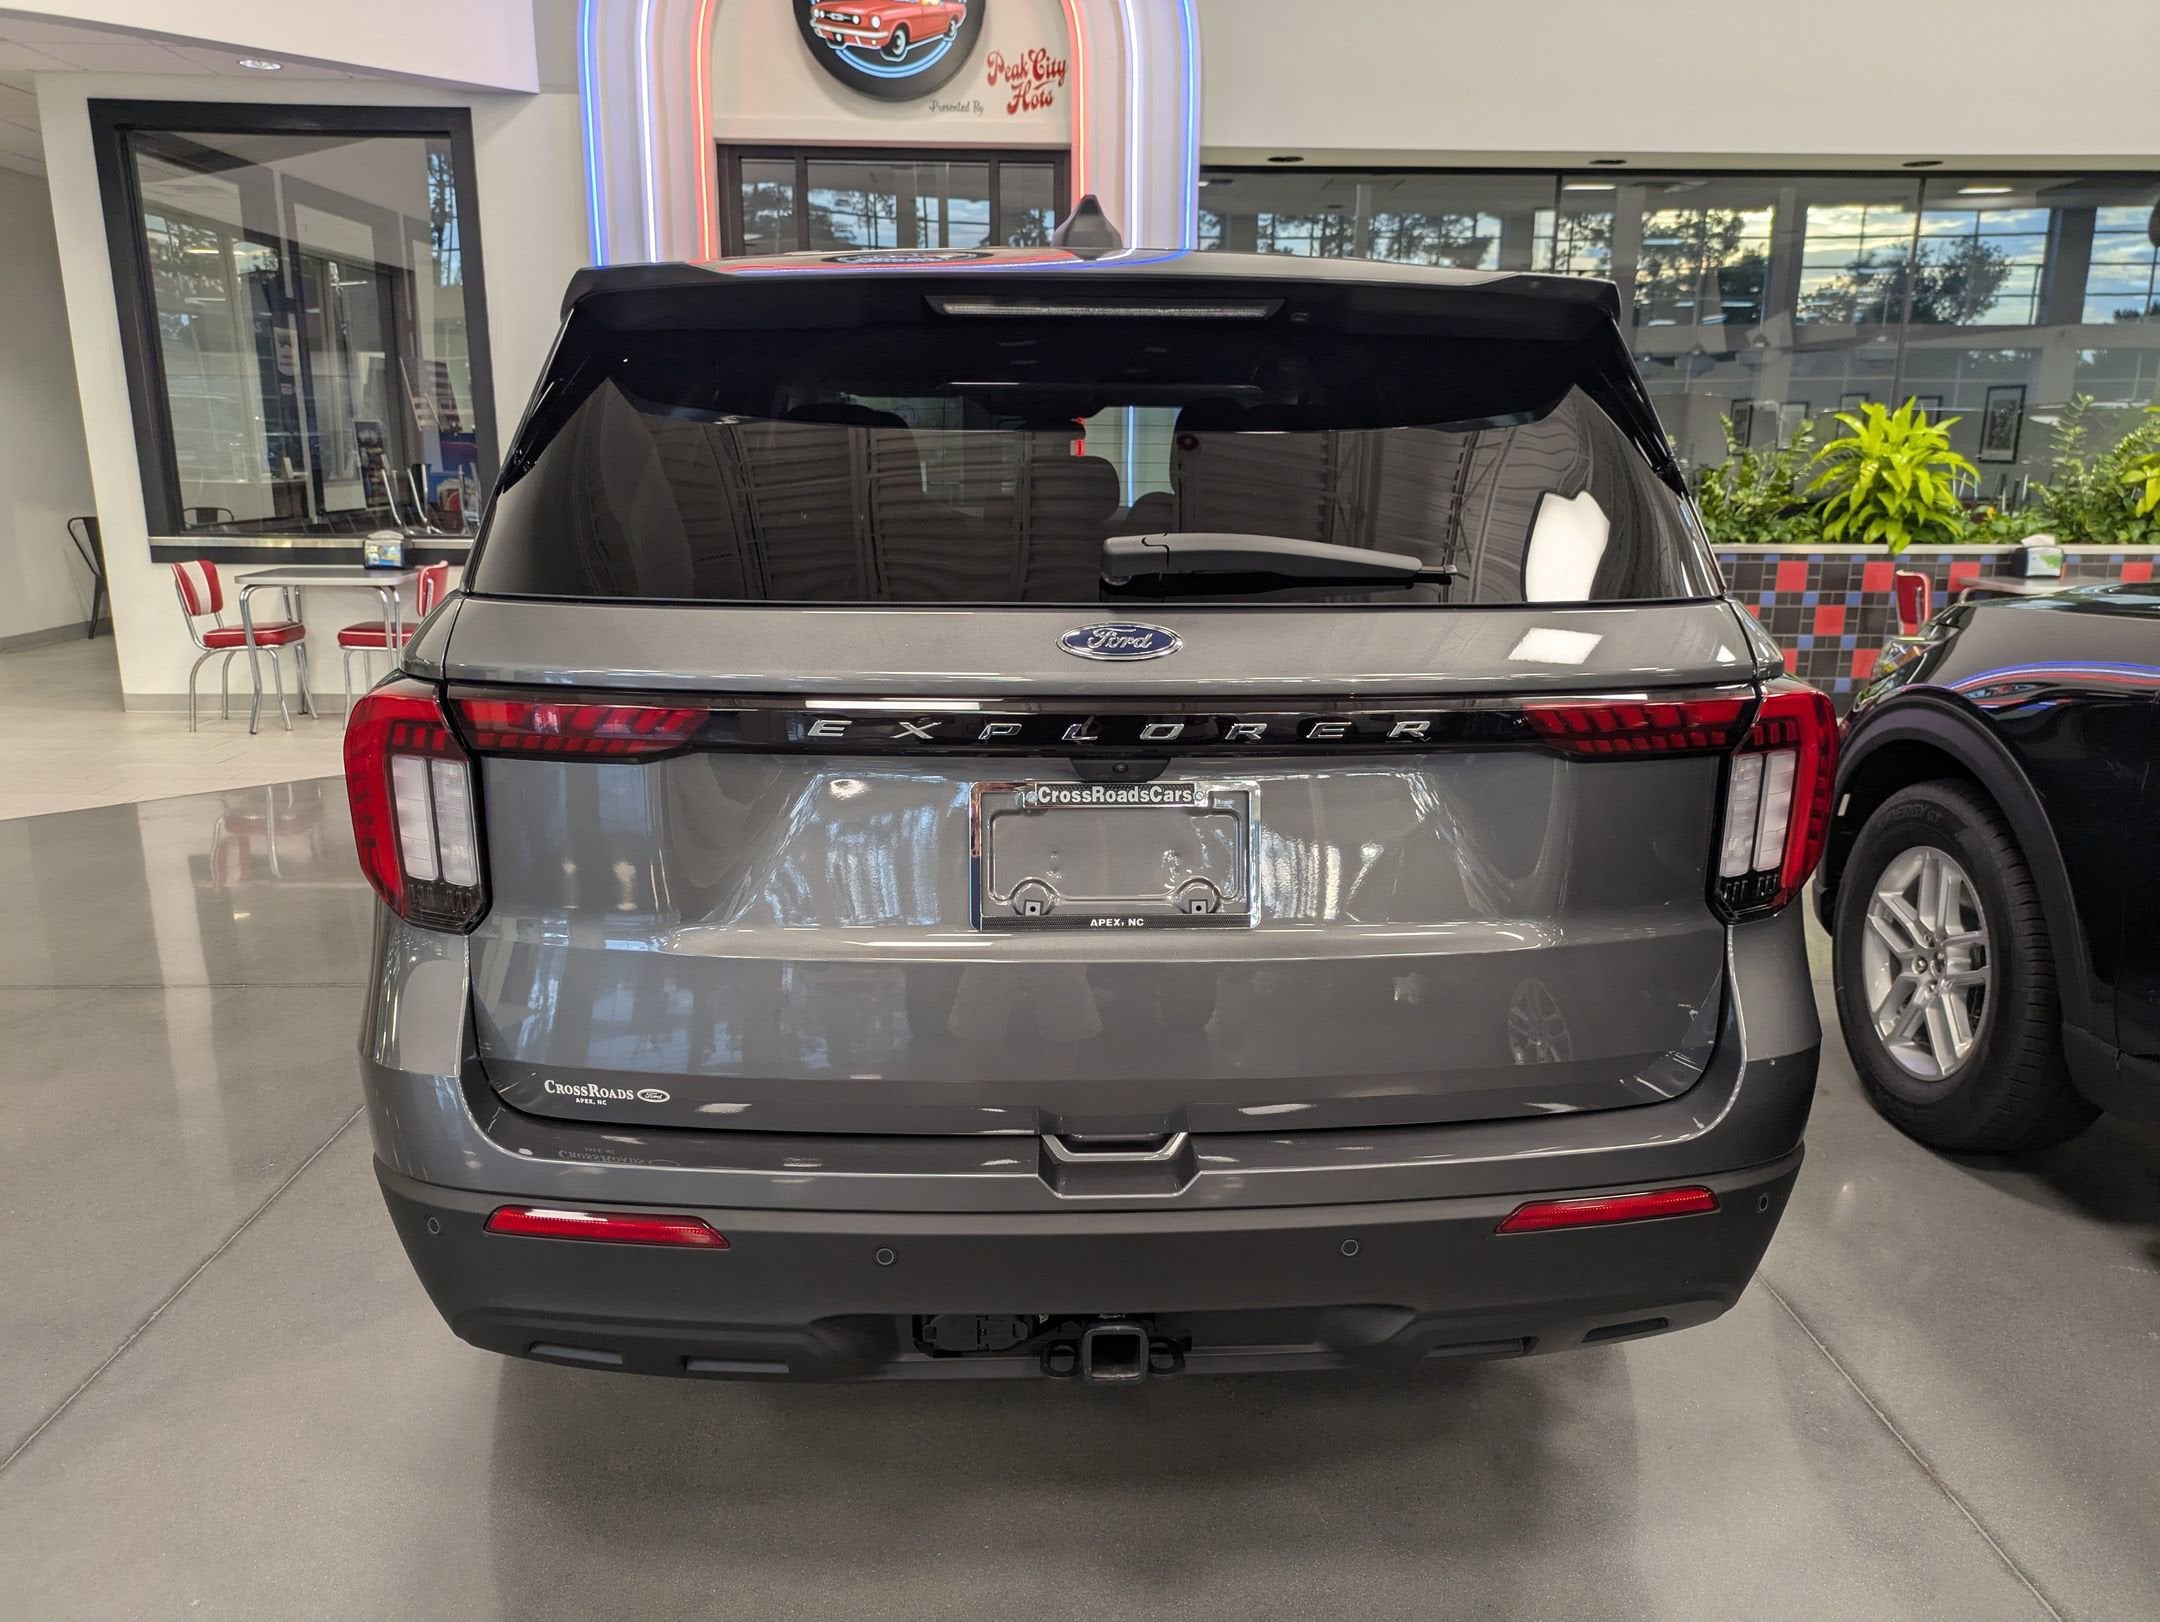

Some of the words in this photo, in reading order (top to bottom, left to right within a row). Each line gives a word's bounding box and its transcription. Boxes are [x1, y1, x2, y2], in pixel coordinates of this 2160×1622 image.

[987, 50, 1030, 88] Peak
[1029, 48, 1067, 88] City
[928, 101, 970, 113] Presented
[973, 101, 984, 116] By
[1006, 81, 1054, 115] Hots
[1087, 627, 1153, 649] Ford
[806, 720, 1431, 741] EXPLORER
[1037, 785, 1193, 804] CrossRoadsCars
[1090, 918, 1126, 928] APEX,
[1128, 918, 1145, 927] NC
